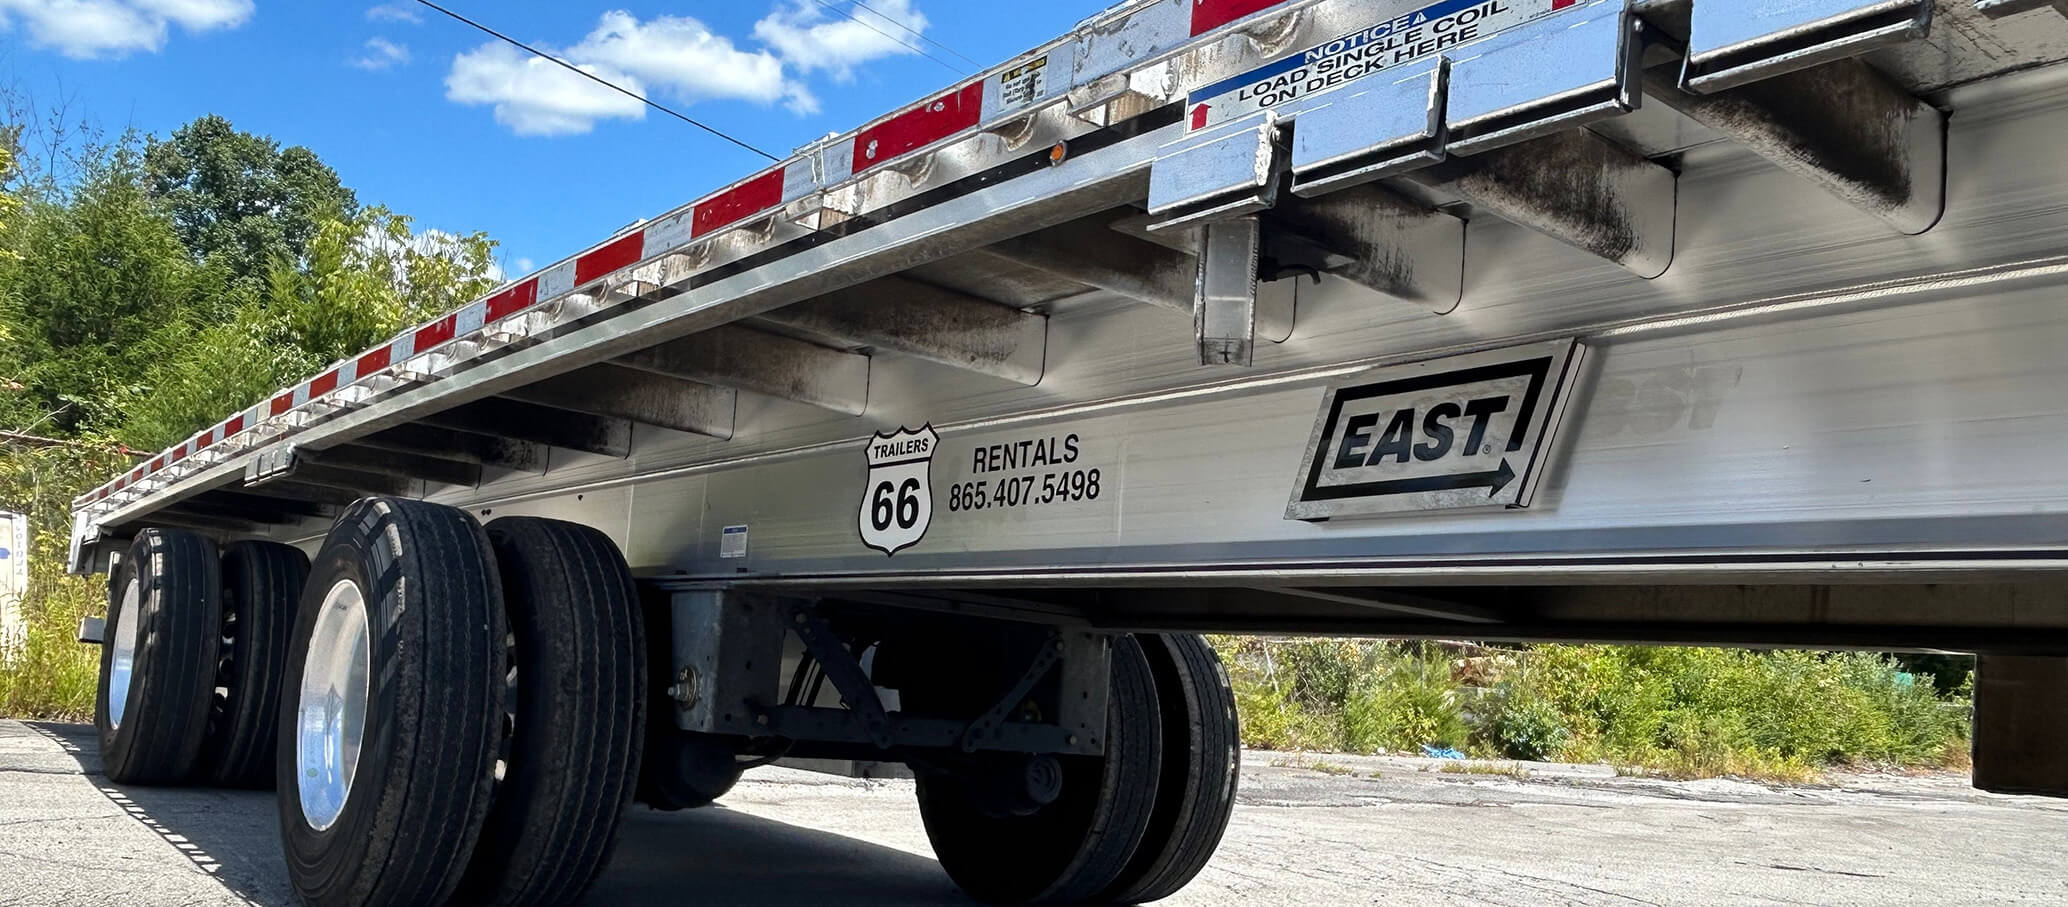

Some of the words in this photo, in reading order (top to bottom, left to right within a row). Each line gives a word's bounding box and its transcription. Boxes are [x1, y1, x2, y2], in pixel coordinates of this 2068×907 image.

[1239, 69, 1308, 101] LOAD
[1317, 27, 1423, 75] SINGLE
[1433, 1, 1509, 34] COIL
[1258, 86, 1297, 107] ON
[1306, 56, 1384, 92] DECK
[1394, 23, 1479, 63] HERE
[1304, 15, 1410, 65] NOTICE
[873, 437, 929, 459] TRAILERS
[972, 433, 1079, 473] RENTALS
[1333, 395, 1510, 470] EAST
[871, 477, 920, 531] 66
[949, 468, 1100, 512] 865.407.5498
